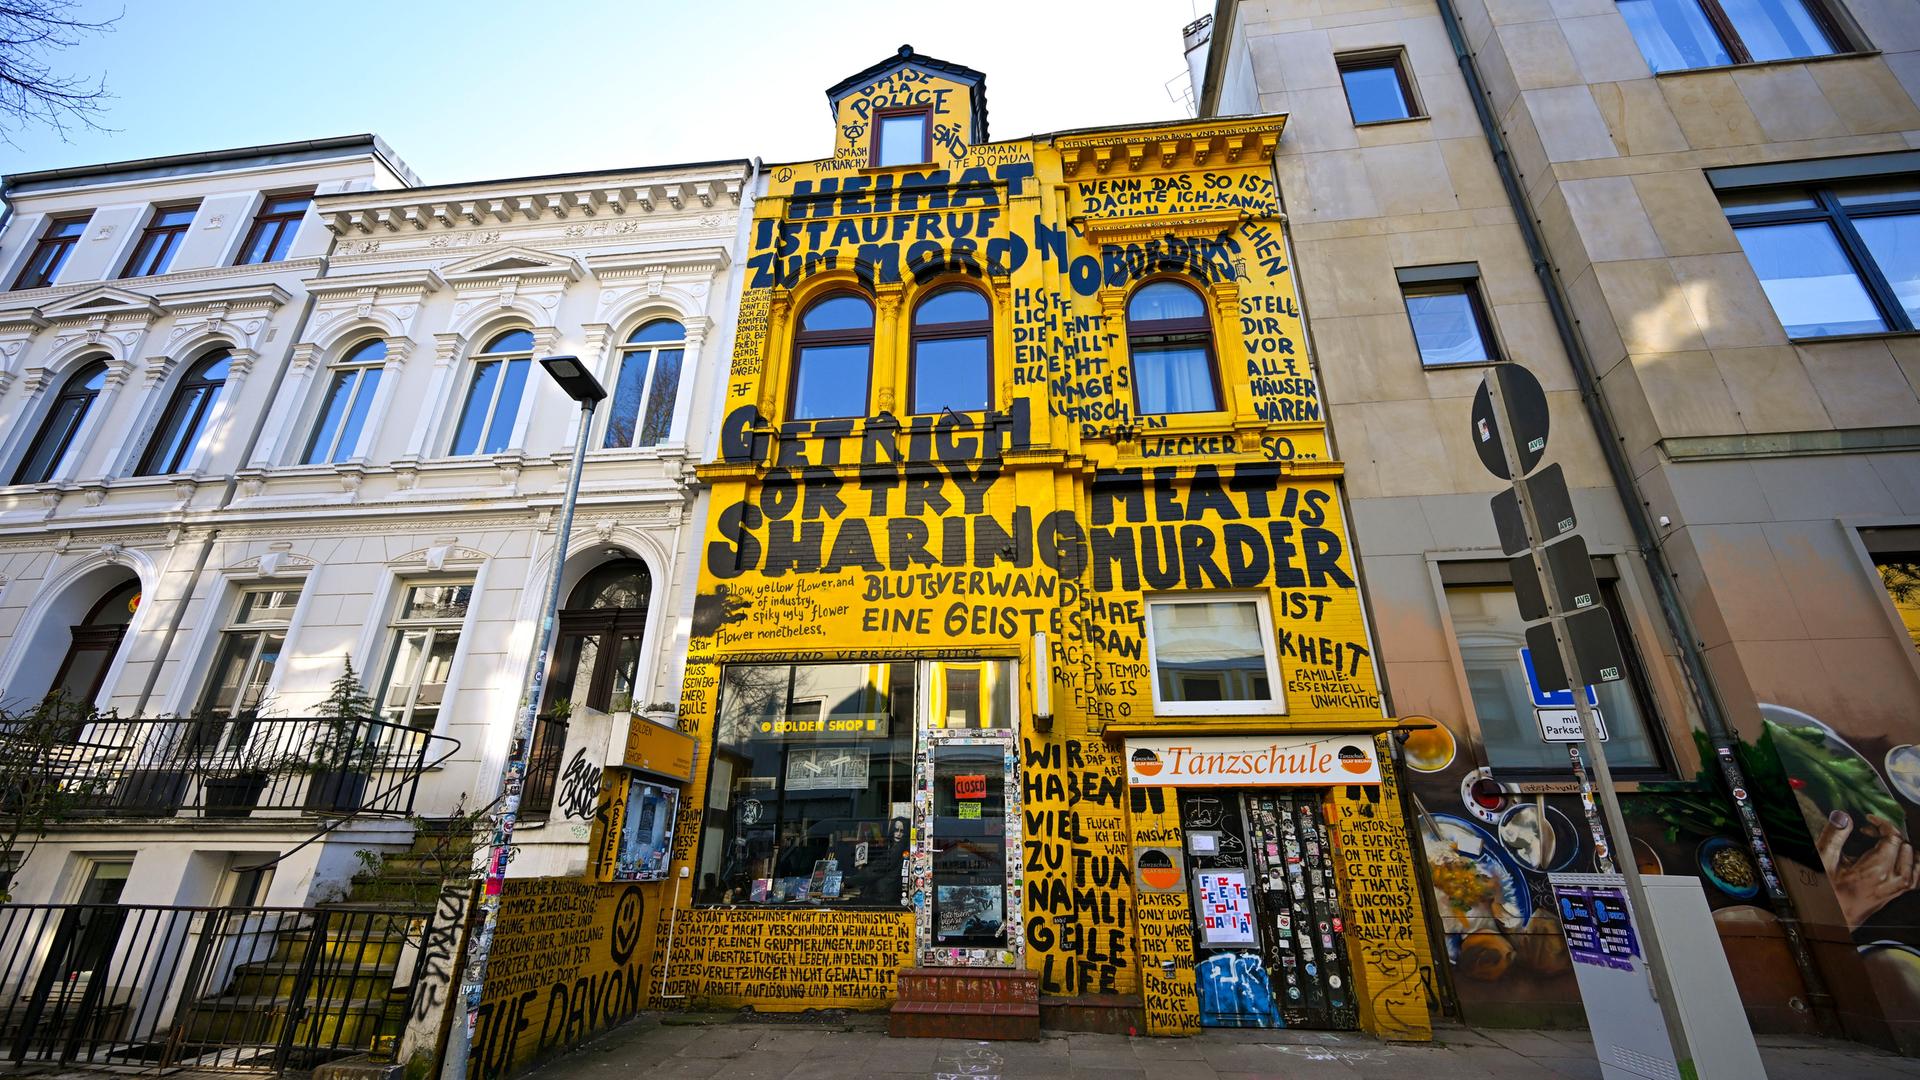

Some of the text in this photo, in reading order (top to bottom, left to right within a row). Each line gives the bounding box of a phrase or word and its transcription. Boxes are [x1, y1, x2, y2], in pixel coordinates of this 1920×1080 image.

[889, 83, 911, 94] LA
[851, 88, 953, 120] POLICE
[1063, 126, 1267, 148] MANCHMAL BAUM UND MANCHMAL
[837, 147, 867, 158] SMASH
[970, 145, 1022, 156] ROMANI
[814, 158, 868, 173] PATRIARCHY
[948, 153, 1030, 169] ITE DOMUM
[788, 162, 1034, 218] HEIMAT
[1079, 178, 1141, 196] WENN
[1152, 175, 1192, 190] DAS
[1204, 173, 1232, 188] SO
[1083, 190, 1167, 213] DACHTE
[756, 209, 1000, 256] IST AUFRUF
[747, 238, 1028, 289] ZUM MORD
[1240, 296, 1299, 318] STELL
[1240, 317, 1284, 335] DIR
[735, 341, 762, 349] FRIEDI-
[1244, 338, 1295, 354] VOR
[734, 349, 758, 358] GENDE
[732, 358, 764, 368] BEZIEH-
[1248, 358, 1300, 376] ALLE
[1251, 377, 1316, 398] HÄUSER
[1254, 397, 1318, 422] WÄREN
[722, 397, 1031, 467] GET RICH
[1141, 435, 1241, 458] WECKER
[1529, 438, 1543, 449] AVB
[760, 462, 1000, 520] OR TRY
[1091, 464, 1330, 527] MEAT IS
[1558, 518, 1573, 530] AVB
[708, 502, 1088, 579] SHARING
[1090, 521, 1357, 592] MURDER
[757, 583, 794, 598] yellow
[758, 598, 766, 610] of
[1281, 591, 1332, 621] IST
[1576, 595, 1590, 605] AVB
[753, 605, 849, 624] spiky ugly flower
[862, 607, 933, 634] EINE
[716, 625, 827, 647] Flower nonetheless,
[689, 640, 711, 651] Star
[1279, 628, 1370, 676] KHEIT
[720, 648, 982, 663] DEUTSCHLAND VERRECKE BITTE
[685, 667, 706, 675] MUSS
[1296, 669, 1348, 681] FAMILIE:
[1601, 668, 1618, 678] AVB
[681, 690, 705, 701] ENER)
[1311, 695, 1379, 709] UNWICHTIG
[679, 702, 707, 716] BULLE
[632, 721, 653, 736] GOLDEN
[677, 719, 699, 732] SEIN
[774, 720, 863, 732] GOLDEN SHOP
[627, 751, 642, 762] SHOP
[1024, 738, 1085, 770] WIR
[1168, 744, 1332, 775] Tanzschule
[955, 780, 985, 793] CLOSED
[1024, 771, 1122, 809] HABEN
[1341, 806, 1352, 817] IS
[683, 823, 698, 833] THE
[1025, 810, 1088, 844] VIEL
[1087, 818, 1121, 830] FLUCHT
[1095, 832, 1108, 842] ICH
[1136, 827, 1181, 842] ANSWER
[1342, 835, 1393, 848] OR EVEN
[1345, 850, 1385, 862] ON THE
[1025, 841, 1132, 890] ZU TUN
[1369, 864, 1382, 877] OF
[1202, 876, 1229, 890] FÜR
[1361, 879, 1392, 892] THAT
[507, 900, 536, 914] IMMER
[1138, 894, 1181, 906] PLAYERS
[1206, 899, 1238, 915] SOLI
[676, 909, 828, 923] DER STAAT VERSCHWINDET NICHT IM
[1139, 909, 1190, 920] ONLY LOVE
[1362, 909, 1375, 924] IN
[529, 913, 592, 933] KONTROLLE UND
[732, 924, 763, 935] MACHT
[768, 923, 838, 937] VERSCHWINDEN
[842, 925, 868, 937] WENN
[1140, 924, 1192, 937] YOU WHEN
[558, 926, 604, 948] JAHRELANG
[718, 937, 909, 953] KLEINEN SEI ES
[1142, 938, 1167, 952] THEY
[533, 945, 591, 971] KONSUM DER
[652, 951, 664, 963] IM
[708, 947, 795, 965] ÜBERTRETUNGEN
[845, 953, 878, 966] DENEN
[882, 953, 899, 967] DIE
[791, 967, 894, 983] NICHT GEWALT IST
[1043, 954, 1119, 995] LIFE
[649, 979, 700, 995] SONDERN
[745, 982, 805, 998] AUFLÖSUNG
[808, 984, 829, 998] UND
[834, 984, 894, 999] METAMOR-
[540, 964, 643, 1050] DAVON
[1147, 994, 1188, 1012] KACKE
[1151, 1012, 1201, 1029] MUSS WEG
